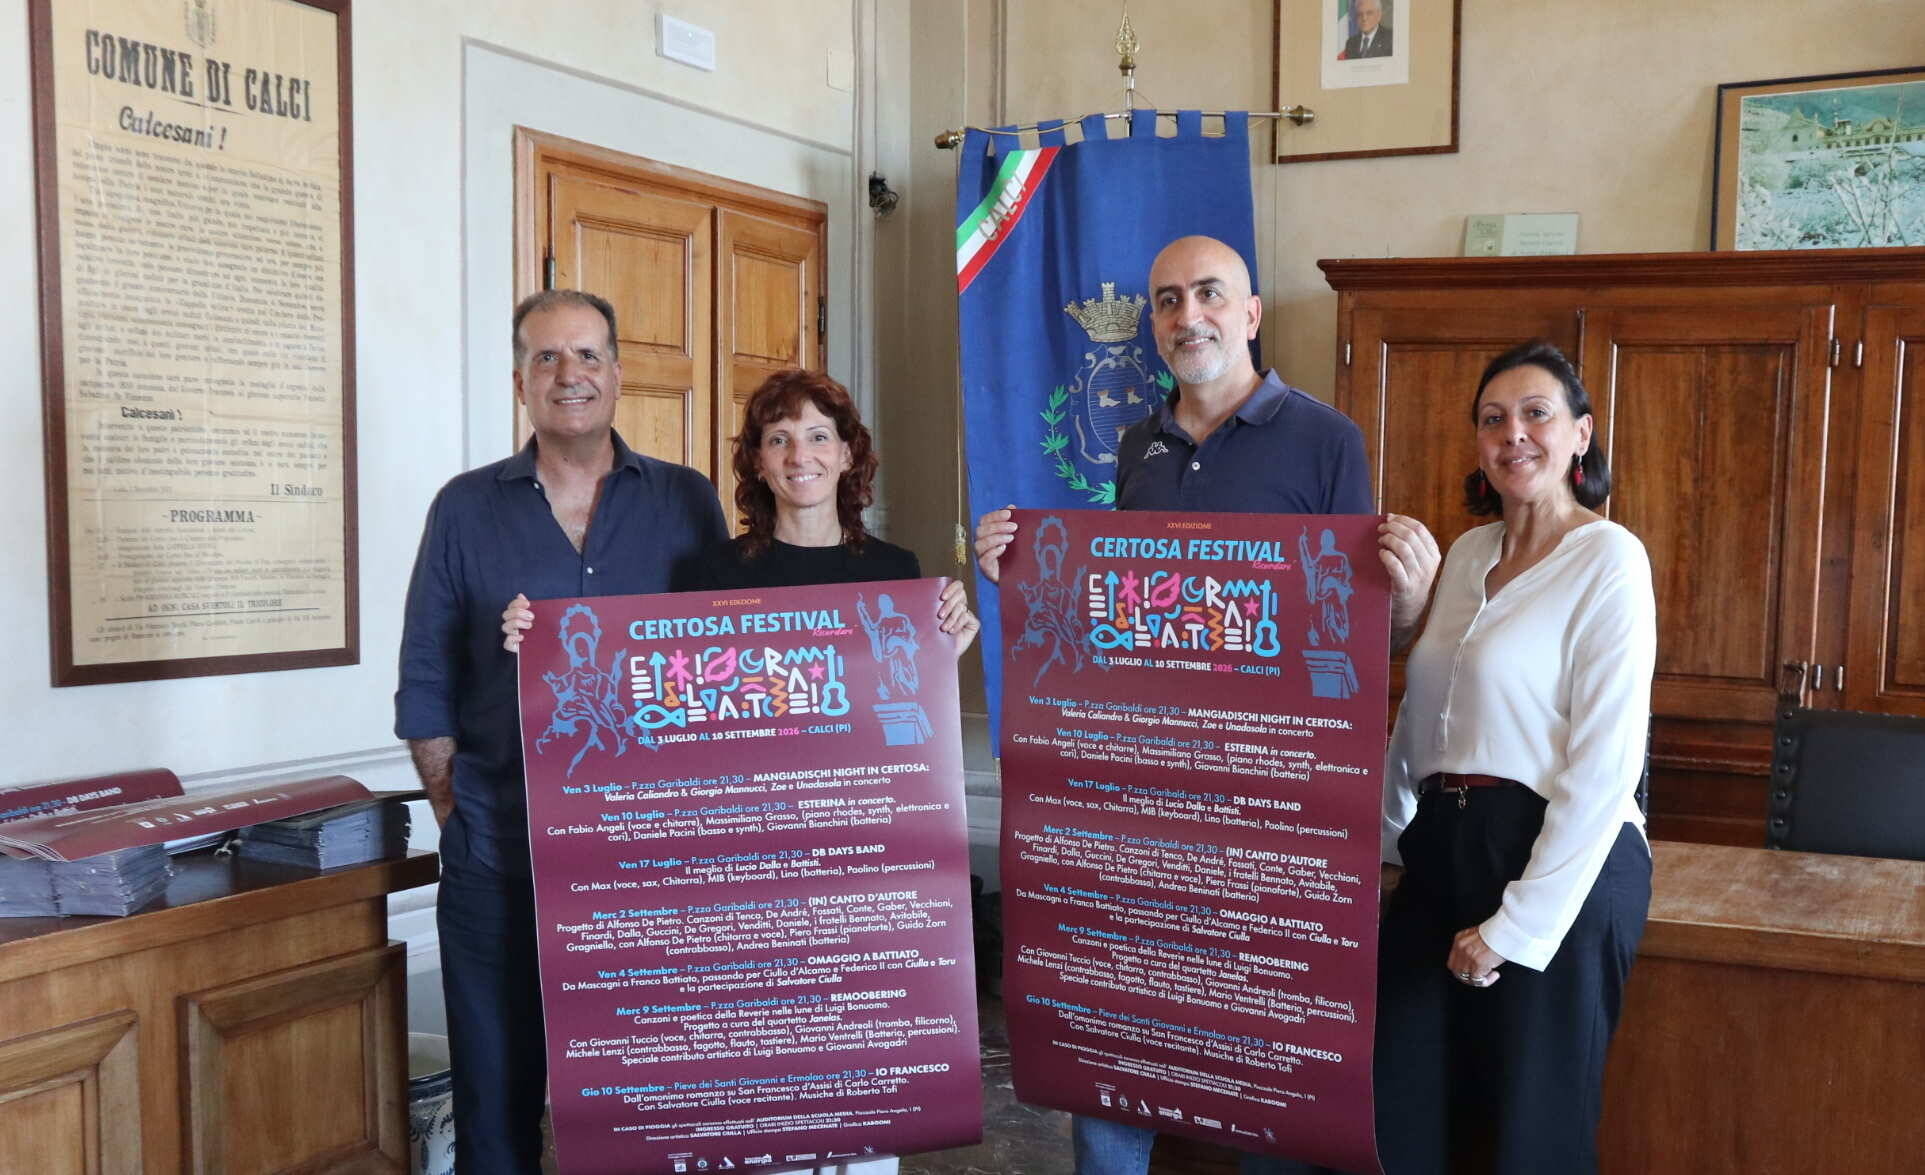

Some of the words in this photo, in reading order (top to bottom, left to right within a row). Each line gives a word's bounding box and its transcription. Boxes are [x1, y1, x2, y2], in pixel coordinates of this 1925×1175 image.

[86, 29, 193, 98] COMUNE
[206, 58, 232, 107] DI
[245, 67, 312, 122] CALCI
[119, 106, 213, 148] Calcesani
[979, 172, 1027, 241] CALCI
[121, 406, 175, 420] Calcesani
[169, 509, 255, 523] PROGRAMMA
[1091, 538, 1181, 559] CERTOSA
[1188, 540, 1284, 561] FESTIVAL
[629, 615, 735, 641] CERTOSA
[741, 608, 845, 634] FESTIVAL
[1093, 656, 1107, 665] DAL
[1115, 657, 1142, 667] LUGLIO
[1144, 659, 1153, 667] AL
[1155, 660, 1164, 668] 10
[1166, 660, 1211, 671] SETTEMBRE
[1241, 665, 1263, 674] CALCI
[1266, 666, 1280, 676] (PI)
[1029, 696, 1044, 705] Ven
[1053, 698, 1076, 710] Luglio
[1106, 702, 1141, 712] Garibaldi
[1188, 708, 1258, 721] MANGIADISCHI
[1260, 714, 1291, 724] NIGHT
[1292, 716, 1303, 725] IN
[1062, 708, 1086, 719] Valeria
[1088, 710, 1123, 722] Caliandro
[1124, 713, 1130, 722] &
[1132, 714, 1160, 727] Giorgio
[1202, 719, 1217, 729] Zoe
[1269, 724, 1276, 734] in
[1278, 725, 1313, 737] concerto
[638, 736, 655, 745] DAL
[658, 735, 665, 744] 3
[663, 733, 697, 744] LUGLIO
[699, 732, 710, 741] AL
[712, 732, 723, 740] 10
[725, 728, 776, 739] SETTEMBRE
[778, 726, 800, 736] 2026
[808, 724, 833, 734] CALCI
[835, 722, 851, 734] (PI)
[563, 786, 581, 795] Ven
[584, 785, 590, 794] 3
[593, 783, 622, 795] Luglio
[658, 778, 700, 789] Garibaldi
[754, 769, 831, 782] MANGIADISCHI
[833, 767, 865, 777] NIGHT
[867, 766, 879, 775] IN
[601, 812, 620, 822] Ven
[622, 811, 633, 820] 10
[635, 809, 665, 822] Luglio
[700, 804, 743, 815] Garibaldi
[798, 798, 846, 809] ESTERINA
[848, 797, 855, 805] in
[619, 860, 637, 869] Ven
[640, 859, 650, 868] 17
[653, 857, 682, 869] Luglio
[717, 852, 759, 863] Garibaldi
[812, 848, 826, 857] DB
[828, 846, 854, 856] DAYS
[856, 844, 885, 854] BAND
[1116, 854, 1126, 864] De
[1233, 869, 1259, 881] fratelli
[593, 910, 617, 920] Merc
[619, 909, 626, 918] 2
[628, 906, 678, 917] Settembre
[714, 901, 755, 912] Garibaldi
[829, 894, 865, 904] CANTO
[1044, 884, 1058, 894] Ven
[1068, 887, 1108, 901] Settembre
[1138, 897, 1173, 910] Garibaldi
[1220, 908, 1268, 923] OMAGGIO
[1270, 915, 1277, 924] A
[1279, 916, 1323, 931] BATTIATO
[617, 1006, 640, 1016] Merc
[643, 1006, 649, 1014] 9
[652, 1002, 701, 1013] Settembre
[737, 997, 778, 1008] Garibaldi
[831, 989, 907, 1002] REMOOBERING
[1027, 995, 1040, 1005] Gio
[1042, 998, 1050, 1007] 10
[1052, 999, 1091, 1015] Settembre
[1099, 1008, 1117, 1020] Pieve
[1119, 1012, 1130, 1022] dei
[1132, 1014, 1150, 1026] Santi
[1152, 1018, 1185, 1032] Giovanni
[1273, 1041, 1283, 1051] IO
[1285, 1043, 1342, 1062] FRANCESCO
